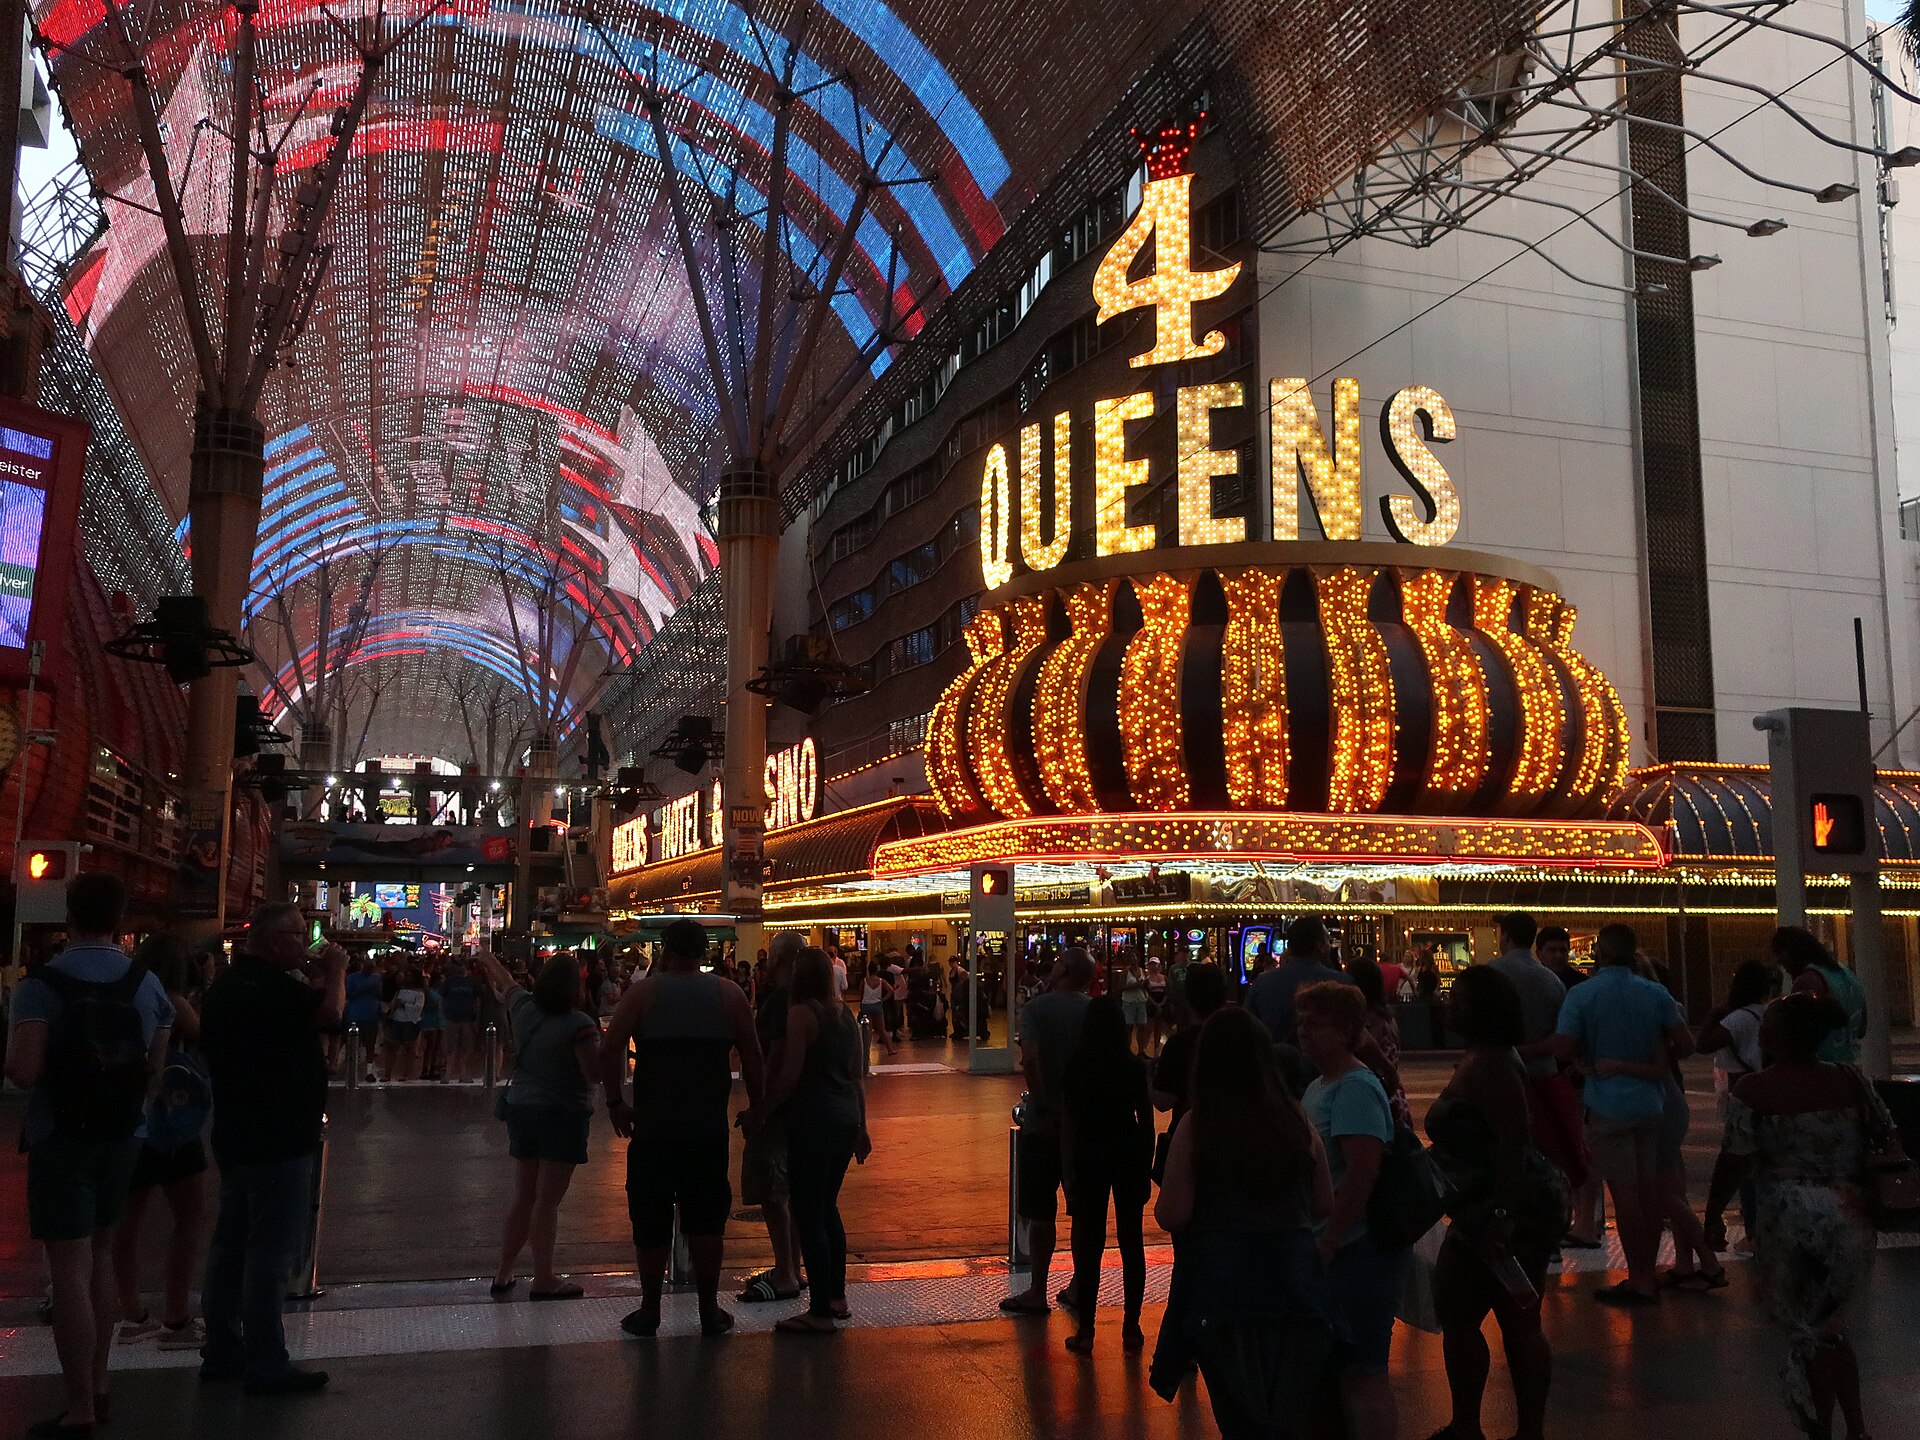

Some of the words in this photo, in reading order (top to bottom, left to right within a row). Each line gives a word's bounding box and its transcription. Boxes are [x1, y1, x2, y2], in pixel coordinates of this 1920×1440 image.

[1093, 172, 1242, 368] 4
[979, 377, 1461, 591] QUEENS
[661, 790, 701, 860] HOTEL
[732, 809, 762, 822] NOW
